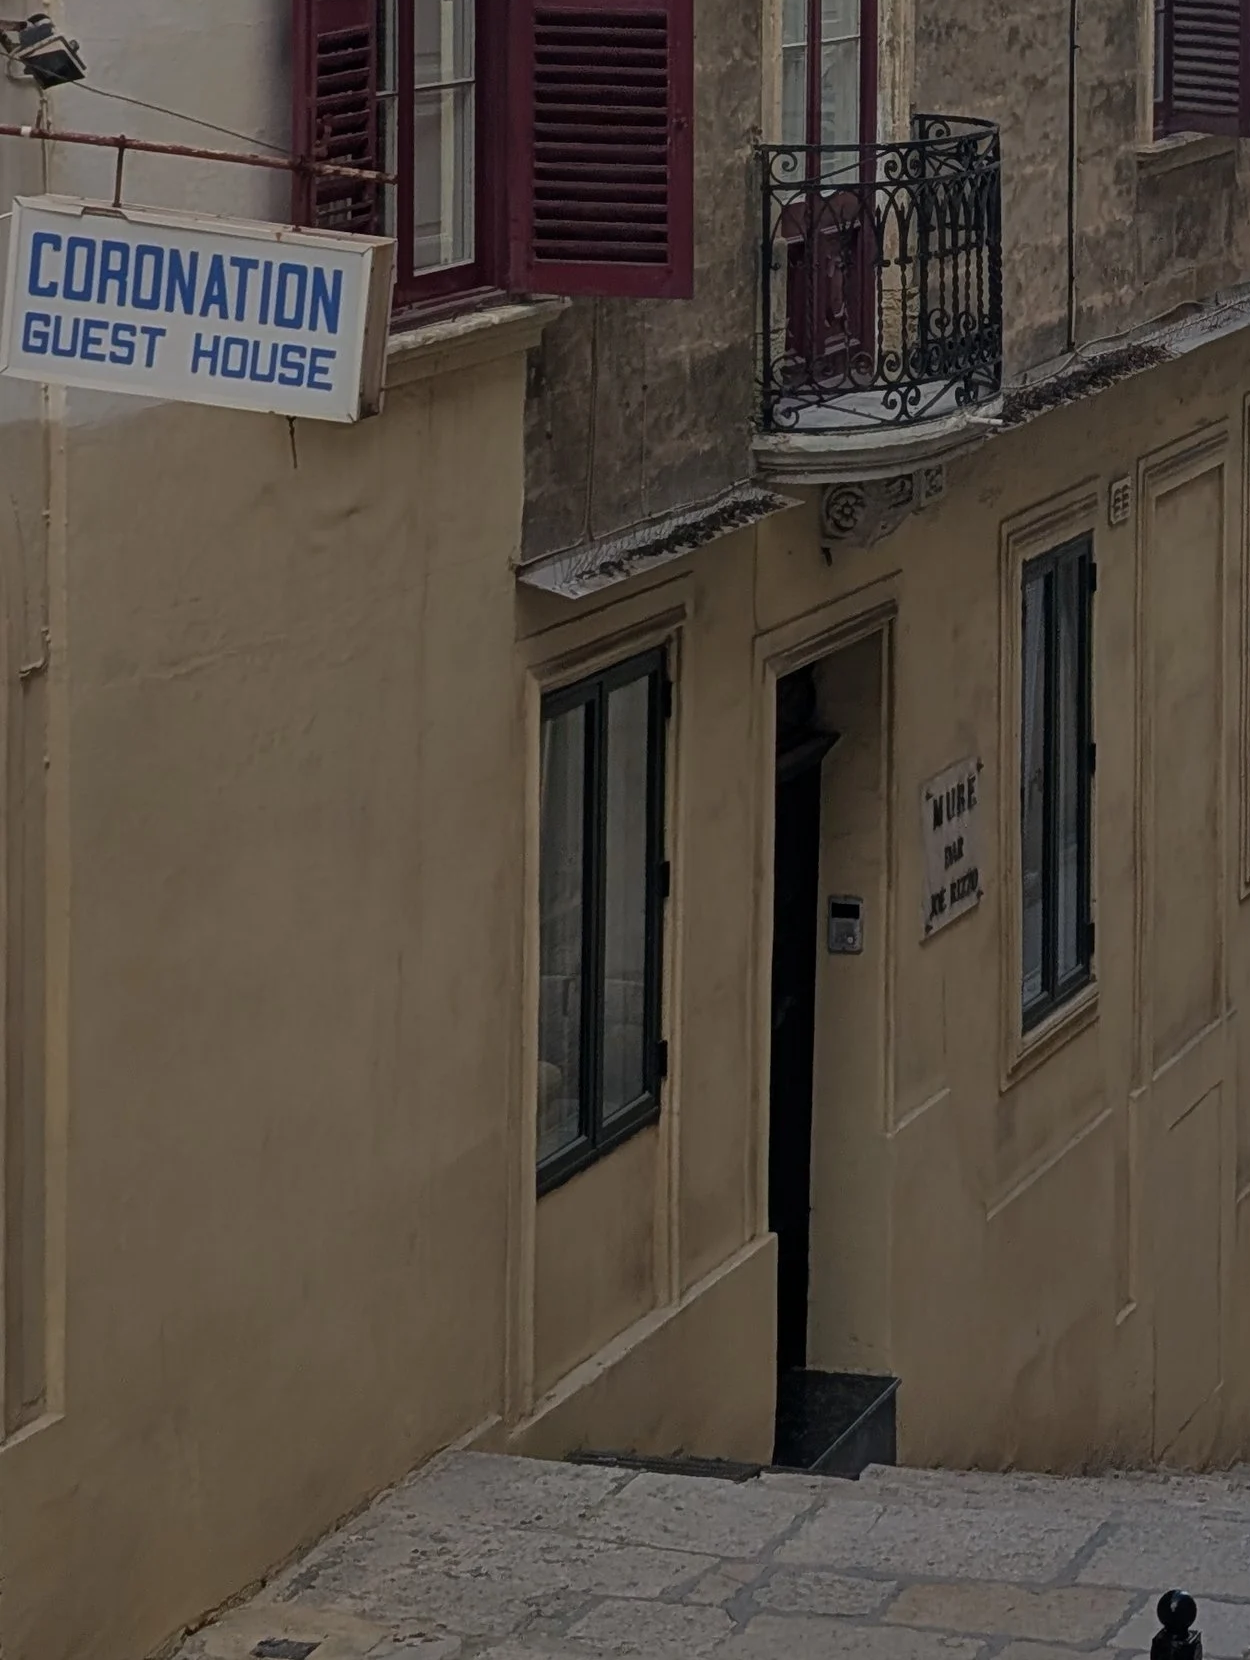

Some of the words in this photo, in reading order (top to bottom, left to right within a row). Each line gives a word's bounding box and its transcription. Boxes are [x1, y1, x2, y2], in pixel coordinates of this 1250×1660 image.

[28, 231, 343, 334] CORONATION
[22, 311, 166, 368] GUEST
[191, 332, 337, 391] HOUSE
